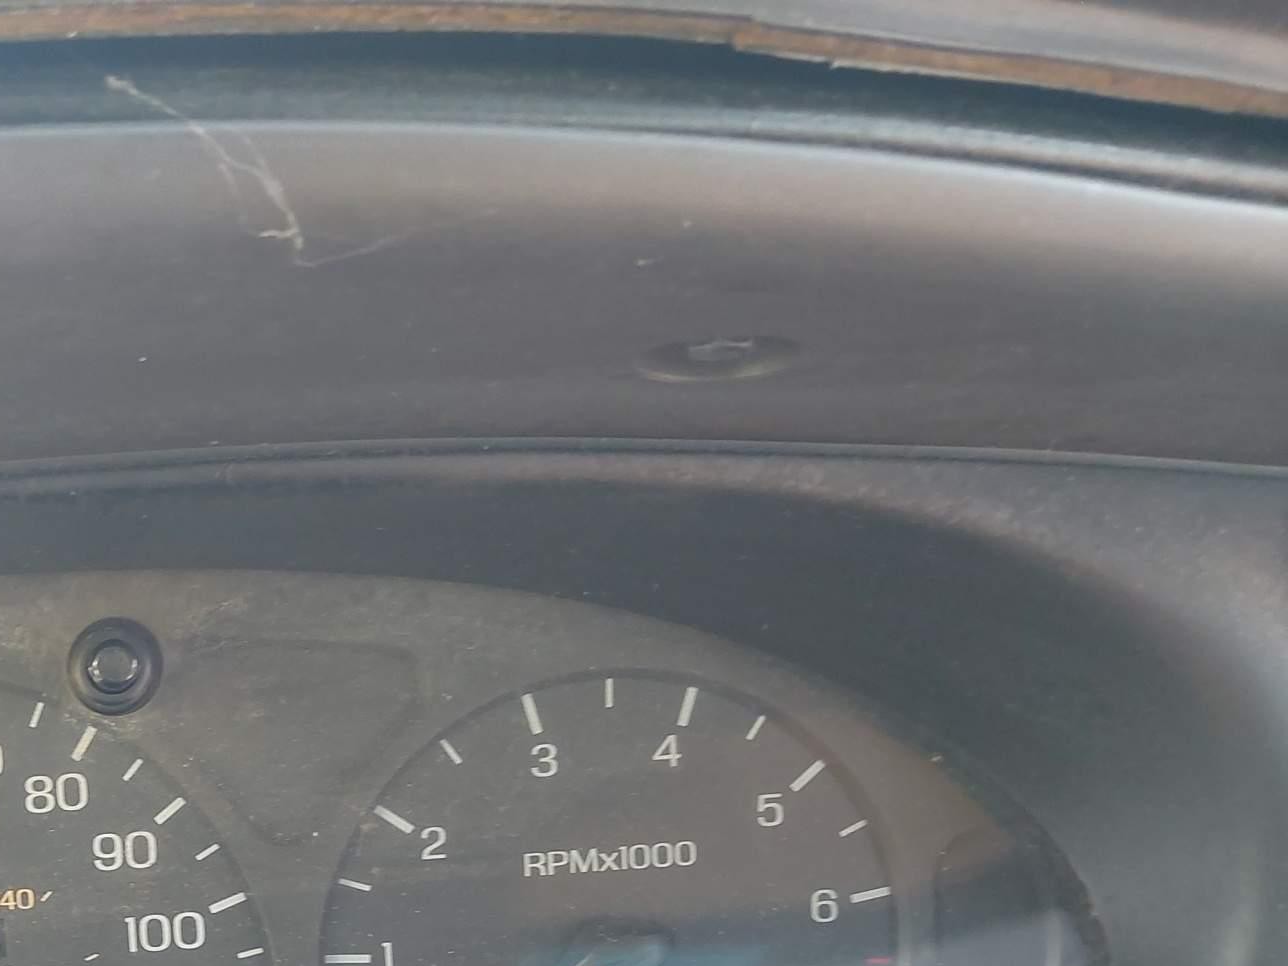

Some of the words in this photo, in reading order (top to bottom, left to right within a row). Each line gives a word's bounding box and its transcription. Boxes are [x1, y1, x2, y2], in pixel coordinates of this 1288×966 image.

[530, 742, 560, 778] 3
[652, 734, 683, 768] 4
[23, 772, 89, 814] 80
[756, 792, 785, 828] 5
[91, 830, 158, 871] 90
[420, 827, 448, 861] 2
[522, 840, 698, 878] RPMx1000
[810, 887, 840, 925] 6
[124, 911, 207, 953] 100
